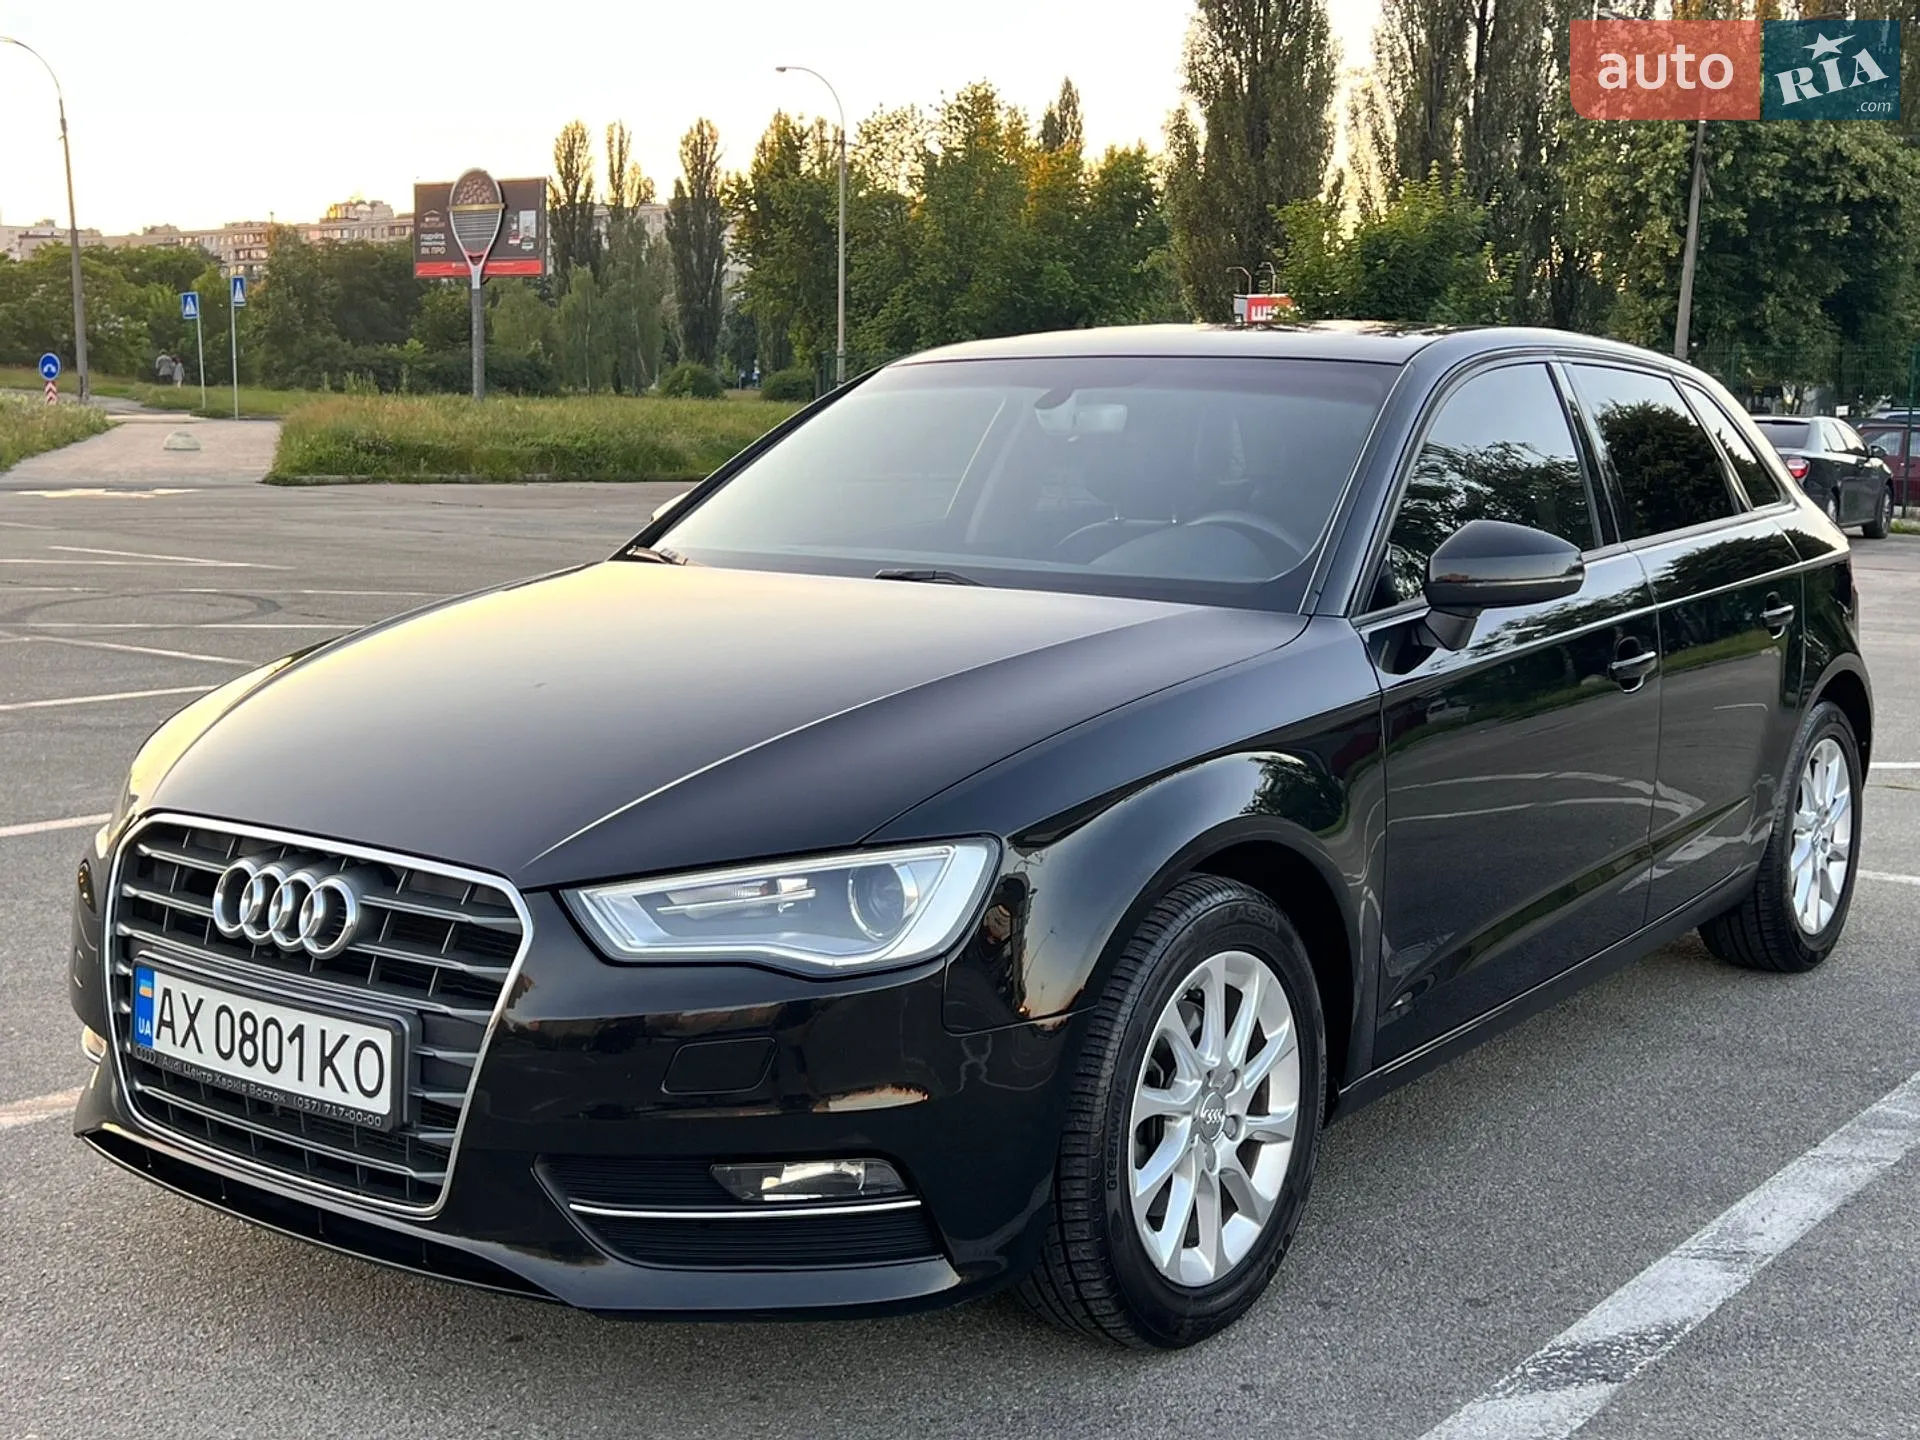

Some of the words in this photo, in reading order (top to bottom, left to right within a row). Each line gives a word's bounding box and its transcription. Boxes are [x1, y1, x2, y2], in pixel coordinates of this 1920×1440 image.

[138, 1017, 152, 1035] UA
[162, 1055, 182, 1072] Audi
[183, 1063, 213, 1083] Центр
[249, 1082, 286, 1103] Восток
[292, 1094, 322, 1113] (057)
[323, 1101, 382, 1127] 717-00-00
